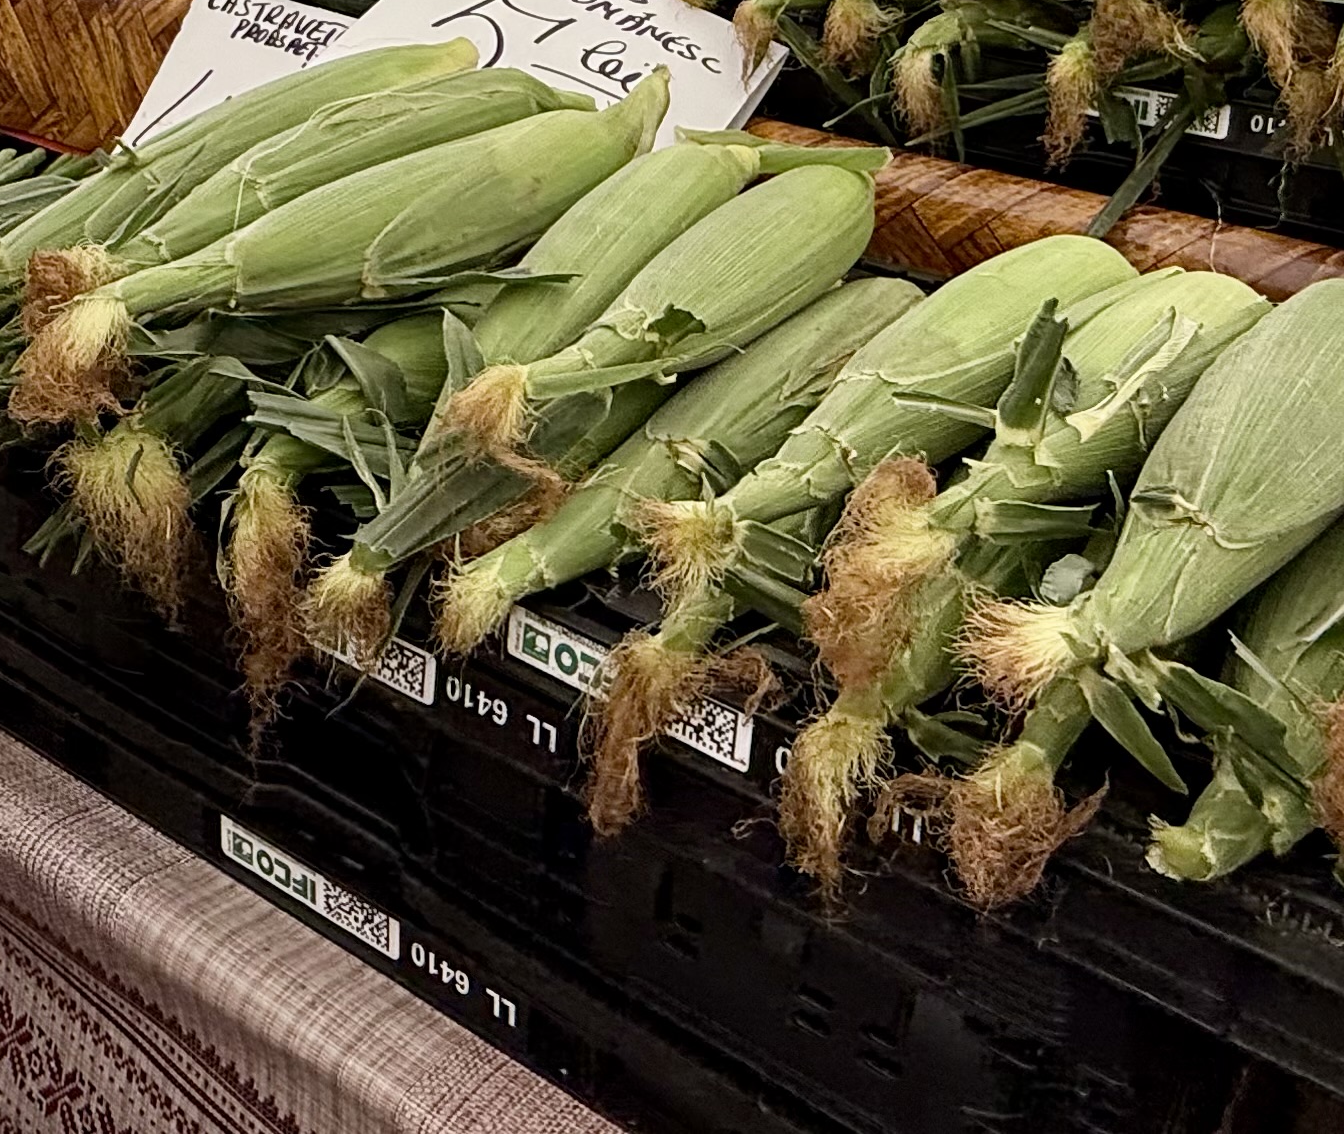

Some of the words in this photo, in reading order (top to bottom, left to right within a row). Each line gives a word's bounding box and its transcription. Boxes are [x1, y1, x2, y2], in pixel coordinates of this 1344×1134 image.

[446, 674, 509, 727] 6410
[526, 713, 558, 754] LL
[255, 848, 319, 907] IFCO
[410, 942, 471, 996] 6410
[485, 987, 517, 1028] LL
